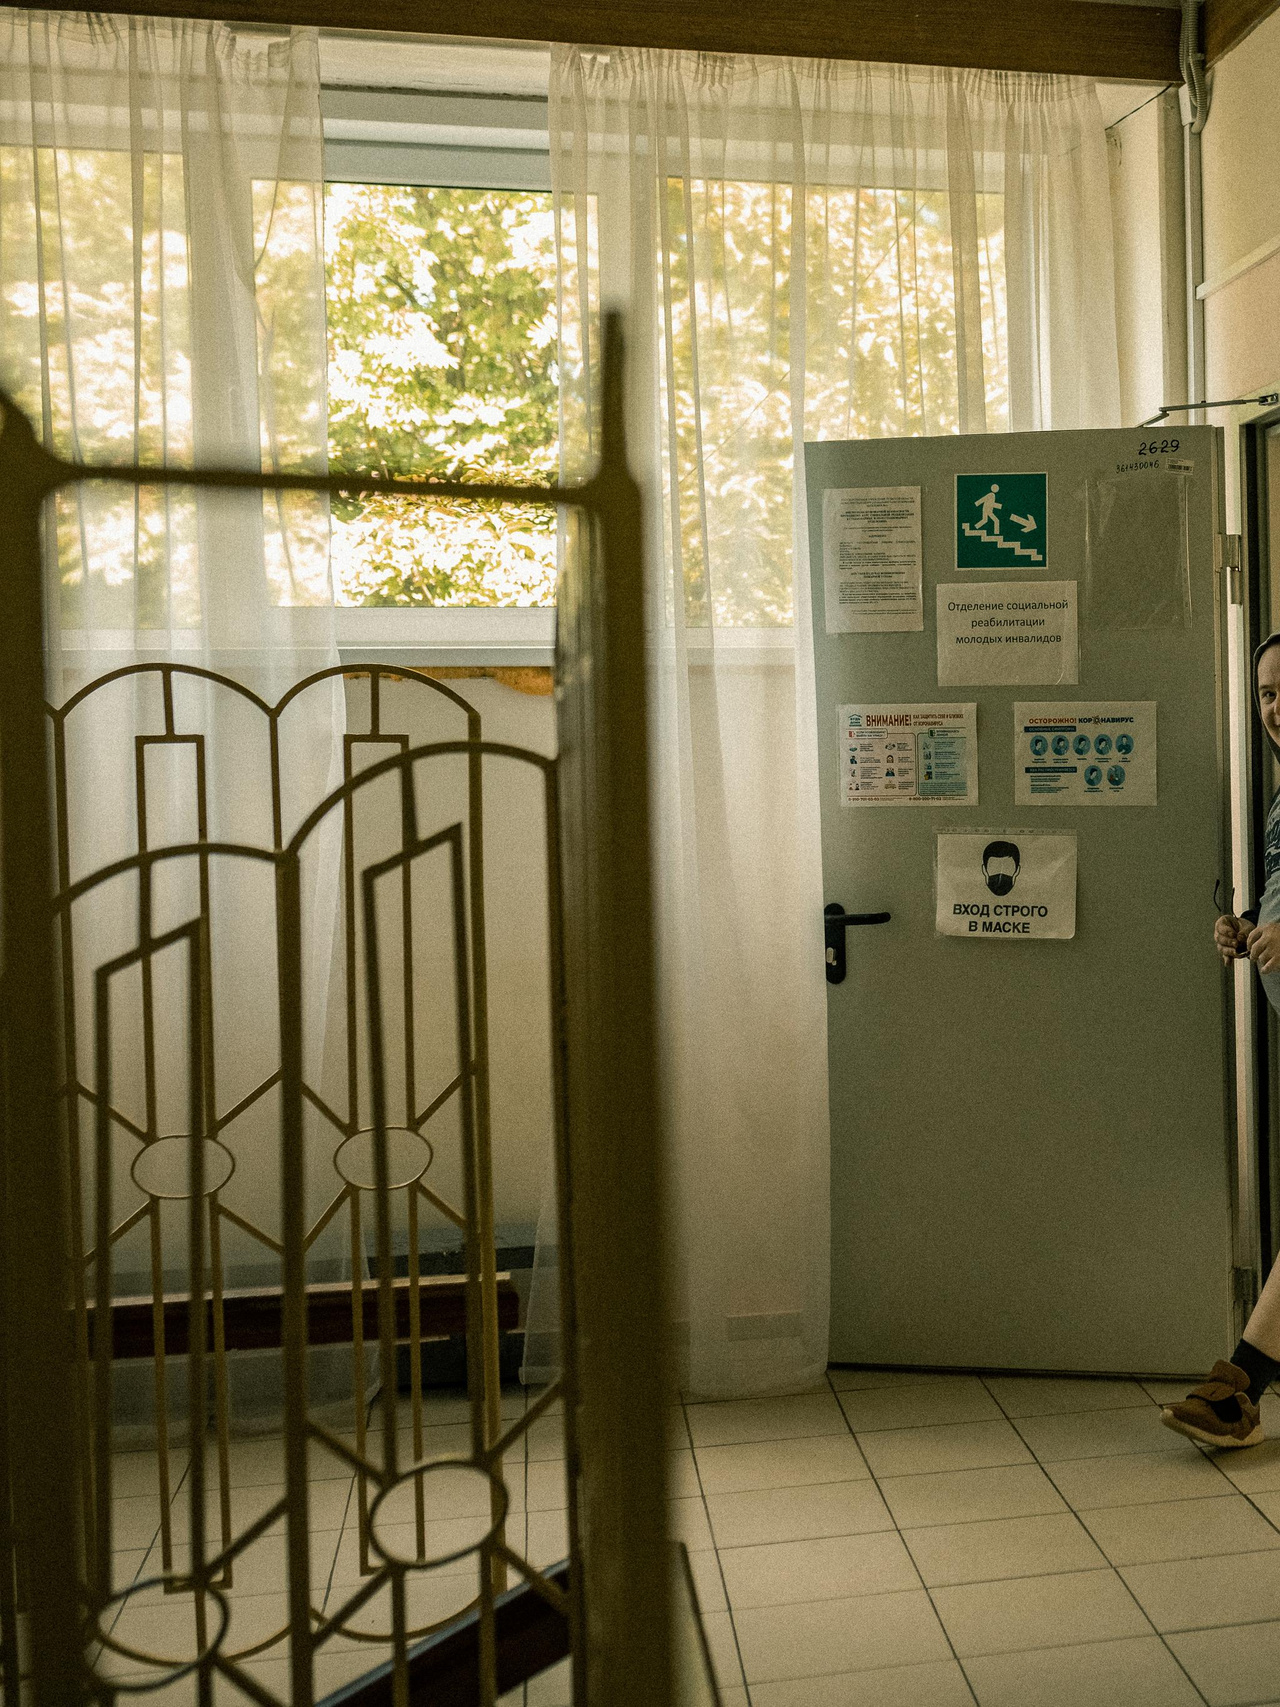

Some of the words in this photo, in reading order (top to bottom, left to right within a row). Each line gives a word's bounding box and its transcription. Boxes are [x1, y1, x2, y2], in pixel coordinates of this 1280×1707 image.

[1138, 439, 1180, 456] 2629
[947, 602, 1004, 613] Отделение
[1006, 600, 1069, 611] социальной
[971, 617, 1045, 629] реабилитации
[955, 636, 1003, 645] молодых
[1005, 634, 1062, 644] инвалидов
[866, 714, 912, 727] ВНИМАНИЕ!
[952, 904, 990, 917] ВХОД
[993, 905, 1048, 917] СТРОГО
[968, 921, 978, 932] В
[982, 921, 1030, 933] МАСКЕ
